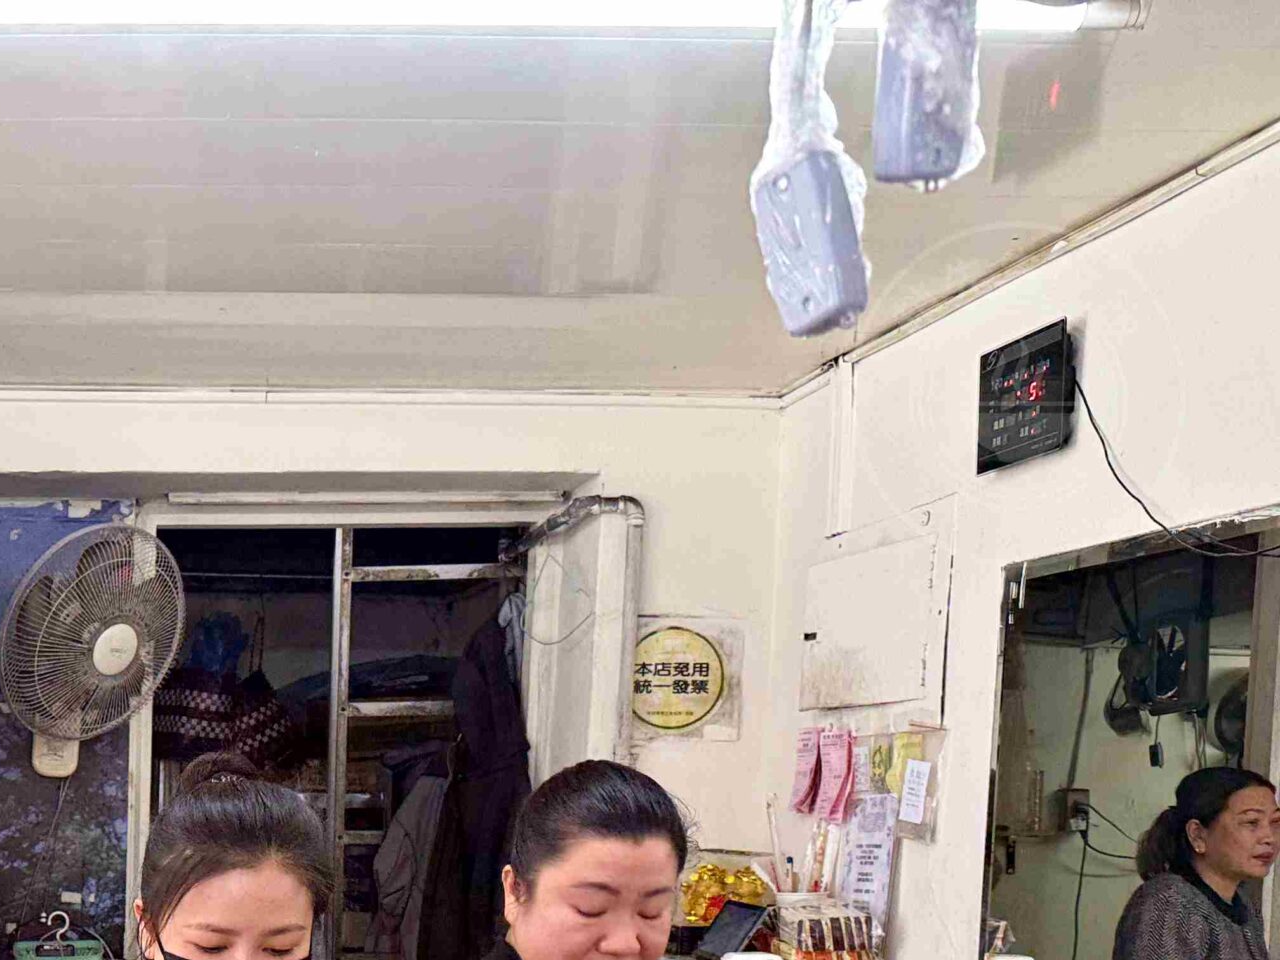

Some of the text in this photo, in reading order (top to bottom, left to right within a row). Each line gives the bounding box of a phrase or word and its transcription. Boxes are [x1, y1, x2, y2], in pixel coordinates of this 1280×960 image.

[634, 662, 710, 677] 本店免用
[633, 680, 710, 695] 統一發票
